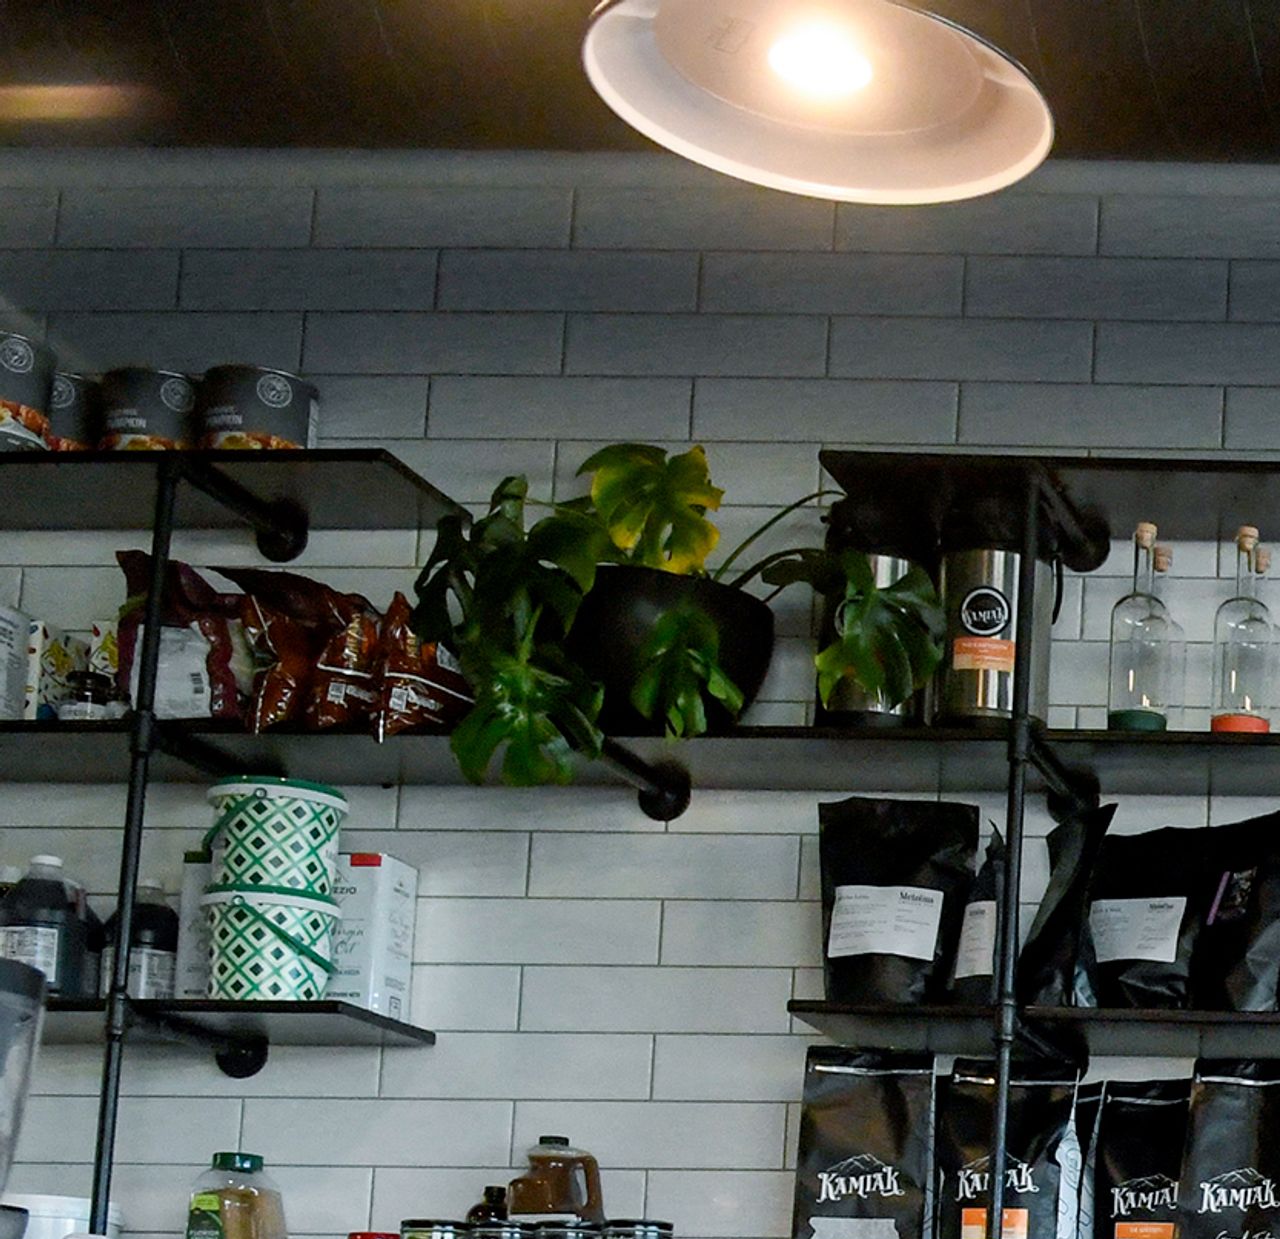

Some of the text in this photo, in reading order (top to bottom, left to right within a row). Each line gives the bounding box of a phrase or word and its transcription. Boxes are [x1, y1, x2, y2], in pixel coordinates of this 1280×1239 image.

[816, 1166, 905, 1203] KAMIAK
[955, 1163, 1040, 1201] KAAK
[1198, 1179, 1280, 1214] KAMIAK
